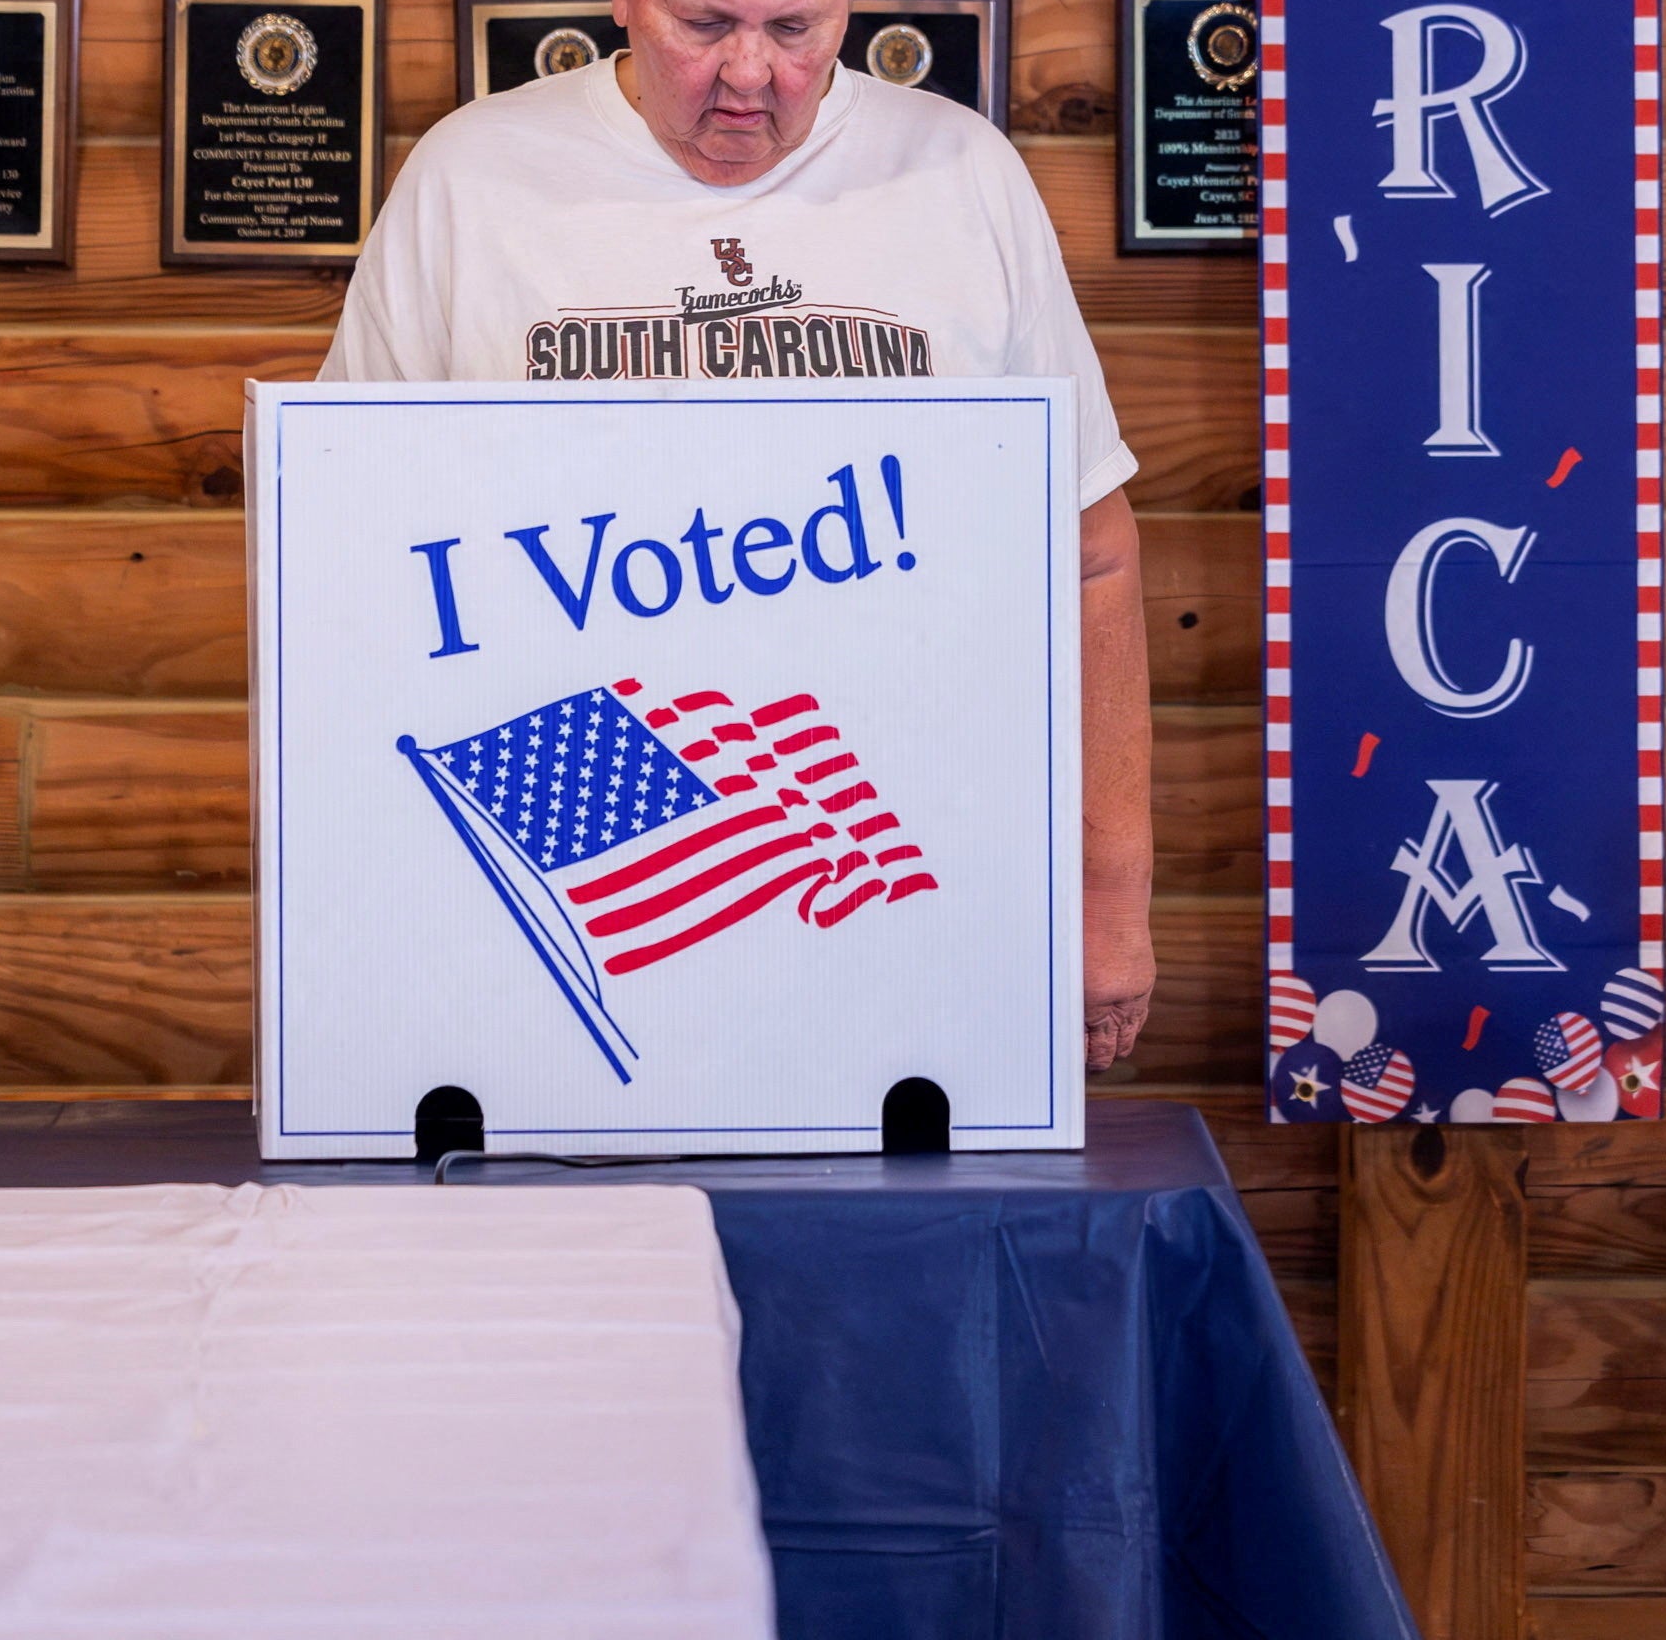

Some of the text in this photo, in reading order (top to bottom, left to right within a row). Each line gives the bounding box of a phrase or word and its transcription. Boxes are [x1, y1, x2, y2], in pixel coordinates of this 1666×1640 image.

[223, 103, 326, 116] The American Legion
[202, 114, 345, 127] Department of South Carolina
[219, 131, 233, 142] 1st
[268, 132, 314, 146] Category
[193, 149, 351, 161] COMMUNITY SERVICE AWARD
[1158, 144, 1189, 154] 100%
[243, 162, 287, 172] Presented
[232, 176, 314, 189] Cayce Post 130
[1157, 175, 1244, 188] Cayce Memorial
[204, 190, 339, 204] For their outstanding service
[254, 204, 288, 213] to their
[290, 215, 307, 225] and
[310, 215, 343, 226] Nation
[237, 228, 272, 237] October
[710, 238, 753, 287] USC
[526, 316, 688, 380] SOUTH
[410, 454, 917, 659] I Voted!
